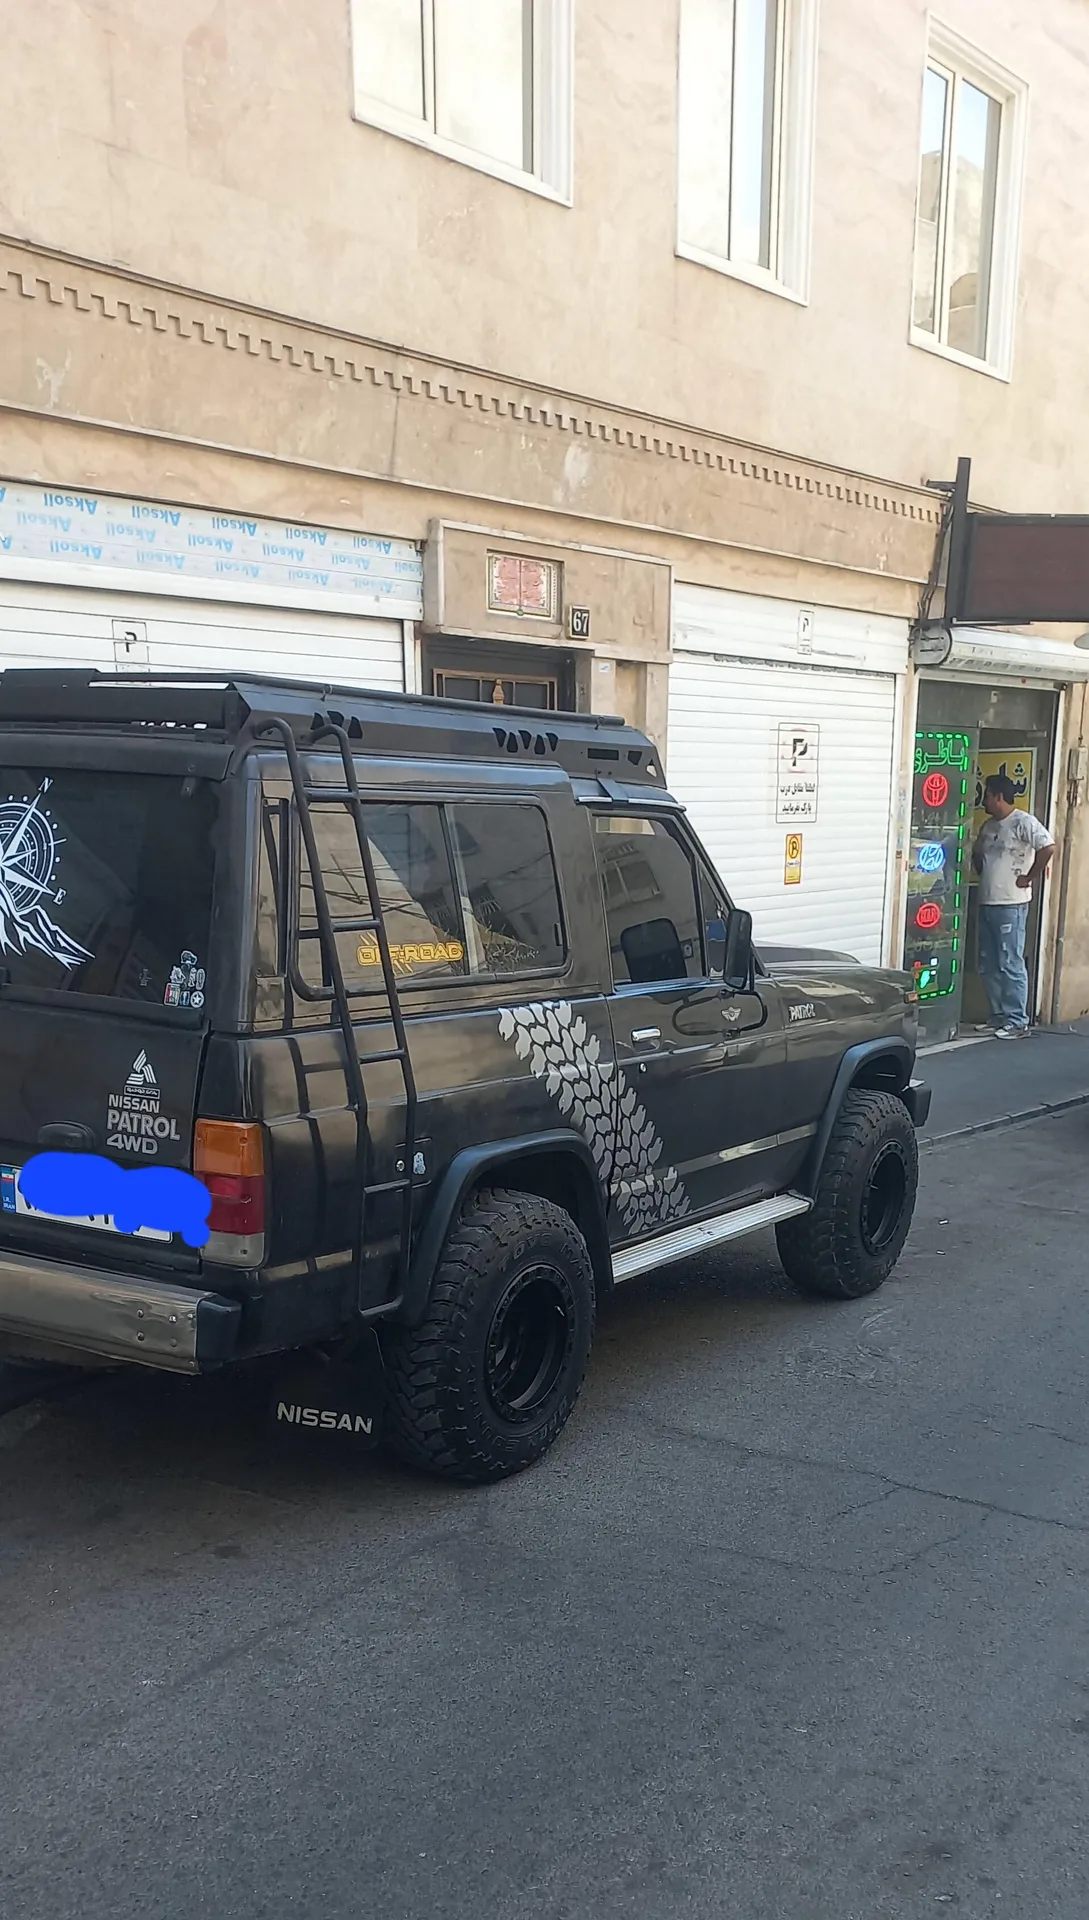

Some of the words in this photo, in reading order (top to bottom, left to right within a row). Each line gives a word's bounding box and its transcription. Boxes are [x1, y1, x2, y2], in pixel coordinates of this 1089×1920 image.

[44, 493, 98, 516] Aksoll
[132, 505, 181, 526] Aksoll
[106, 522, 156, 543] Aksoll
[212, 516, 258, 536] Aksoll
[188, 534, 234, 553] Aksoll
[286, 528, 327, 546] Aksoll
[353, 536, 392, 554] Aksoll
[50, 540, 103, 560] Aksoll
[136, 550, 186, 569] Aksoll
[262, 542, 305, 562] Aksoll
[288, 570, 329, 586] Aksoll
[573, 611, 589, 634] 67
[792, 738, 808, 767] P
[38, 776, 53, 793] N
[53, 888, 67, 905] E
[108, 1094, 160, 1113] NISSAN
[107, 1109, 181, 1141] PATROL
[106, 1133, 158, 1155] 4WD
[277, 1402, 373, 1434] NISSAN
